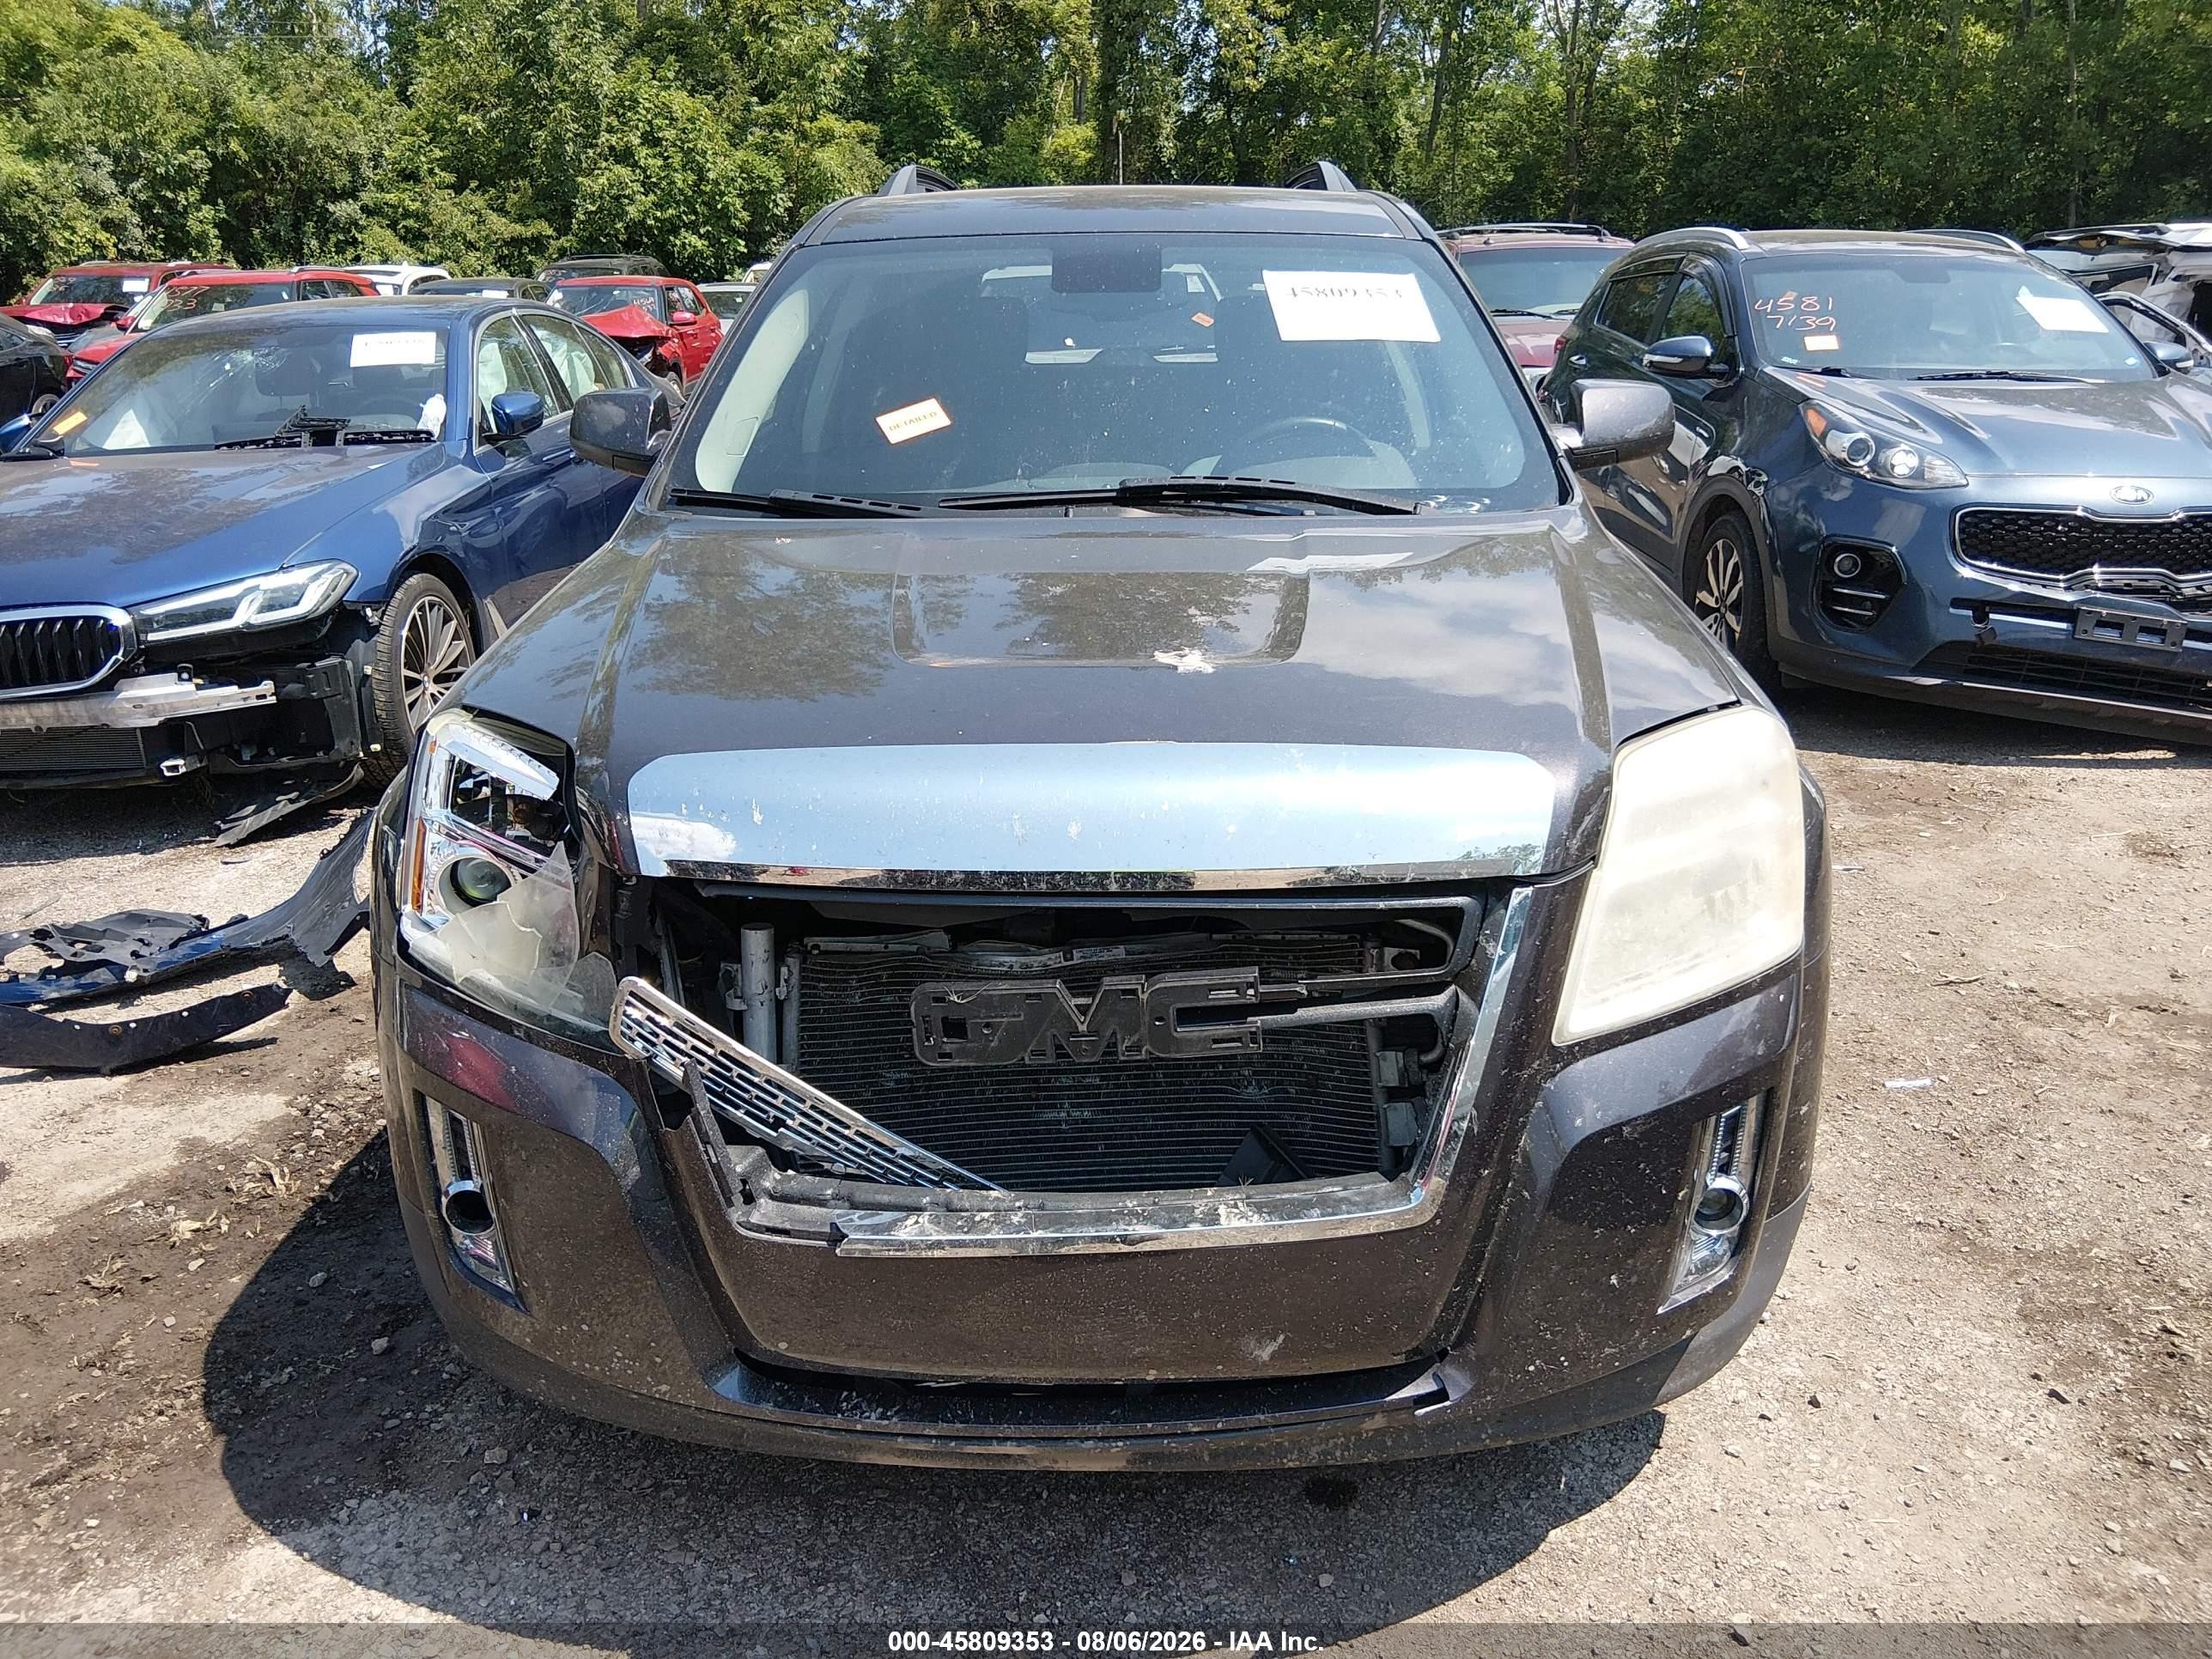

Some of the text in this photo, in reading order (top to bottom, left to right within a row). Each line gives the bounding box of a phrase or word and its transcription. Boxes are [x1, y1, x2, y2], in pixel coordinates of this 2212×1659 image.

[1754, 296, 1832, 313] 4581
[1765, 315, 1836, 331] 7139
[910, 967, 1262, 1066] GMC
